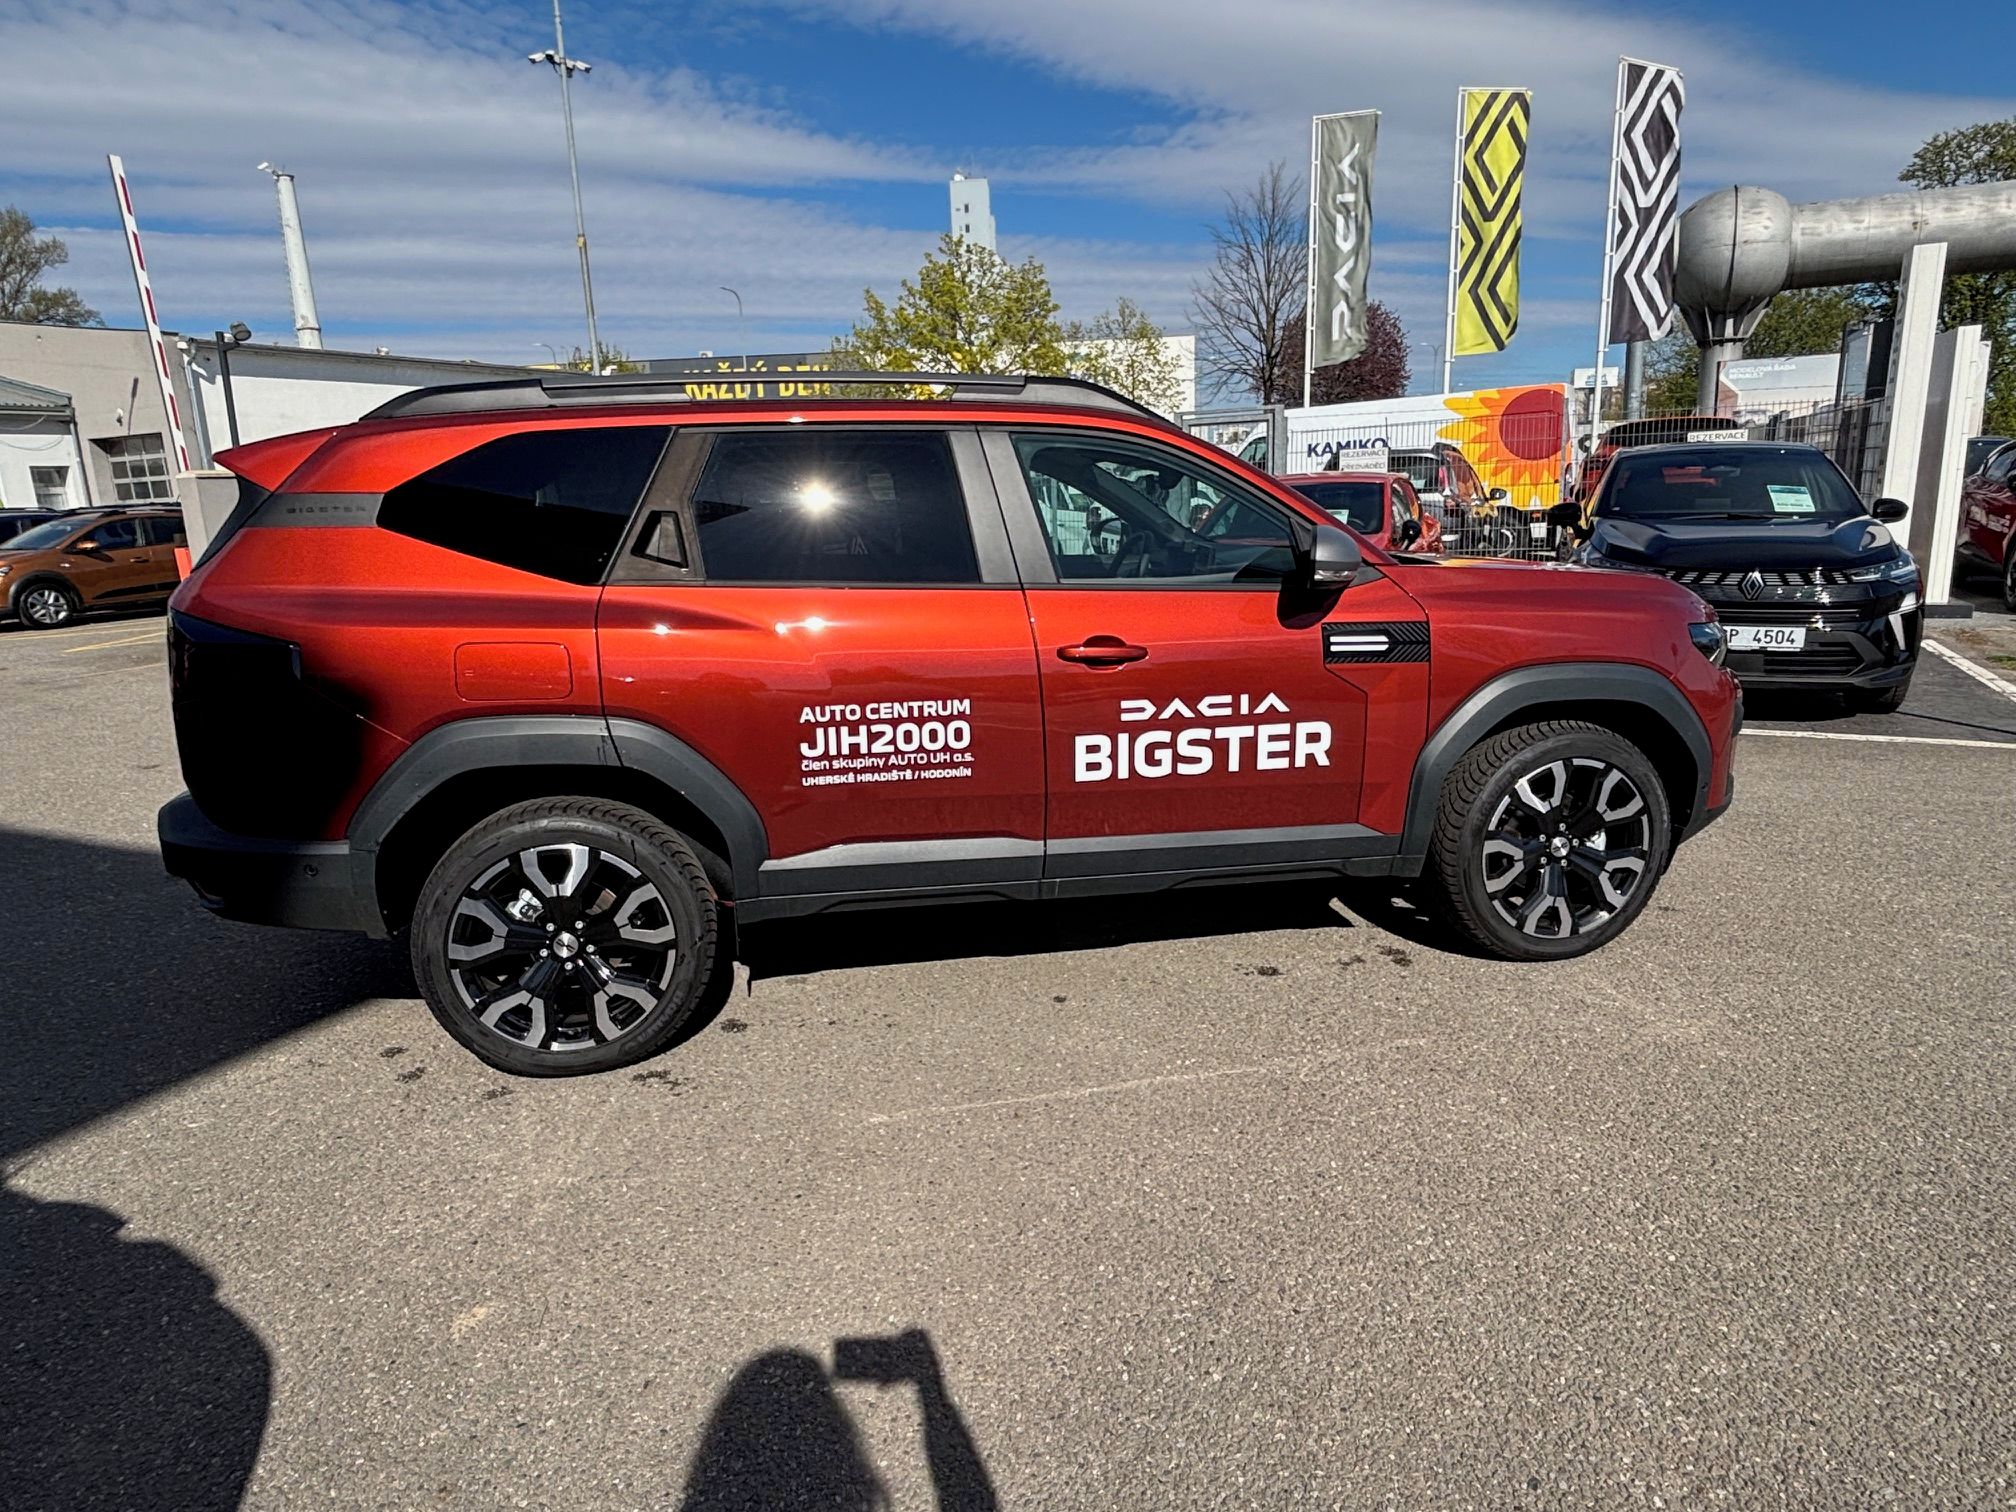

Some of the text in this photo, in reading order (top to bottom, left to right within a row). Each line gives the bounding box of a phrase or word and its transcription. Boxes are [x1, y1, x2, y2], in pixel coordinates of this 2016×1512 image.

[683, 360, 768, 400] KAŽDÝ
[1307, 437, 1388, 457] KAMIKO
[1689, 432, 1746, 441] REZERVACE
[1341, 449, 1386, 458] REZERVACE
[1752, 629, 1796, 645] 4504
[800, 699, 971, 723] AUTO CENTRUM
[1120, 692, 1290, 722] DACIA
[800, 720, 971, 758] JIH2000
[801, 751, 975, 771] člen skupiny AUTO UH a.s.
[1074, 721, 1332, 783] BIGSTER
[802, 771, 855, 787] UHERSKÉ
[857, 768, 913, 783] HRADIŠTĚ
[920, 766, 972, 780] HODONÍN
